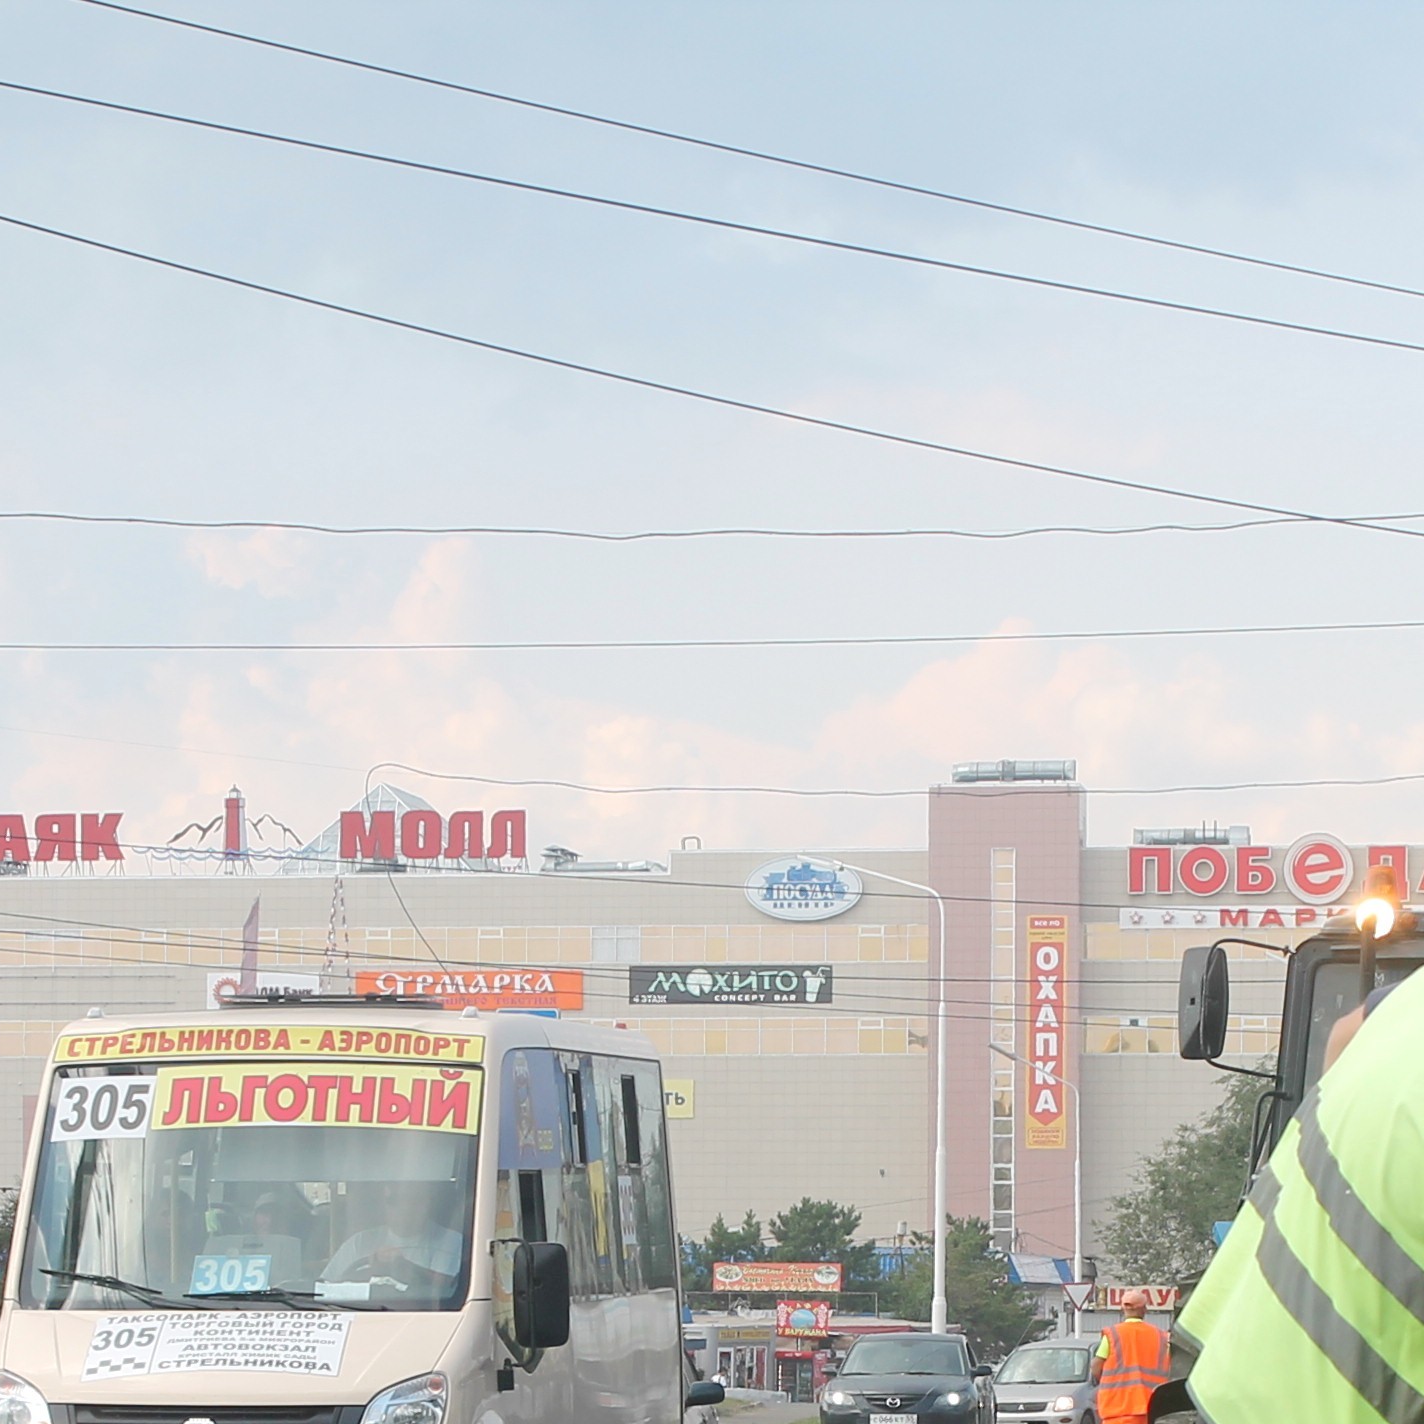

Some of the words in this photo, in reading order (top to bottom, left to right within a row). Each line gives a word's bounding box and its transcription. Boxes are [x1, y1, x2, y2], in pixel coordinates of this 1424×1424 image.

[339, 809, 527, 859] МОЛЛ
[375, 971, 556, 996] ЯРМАРКА
[714, 994, 765, 1002] CONCEPT
[774, 994, 797, 1002] BAR
[1034, 945, 1059, 1113] ОХАПКА
[67, 1029, 291, 1058] СТРЕЛЬНИКОВА
[317, 1029, 471, 1058] АЭРОПОРТ
[59, 1082, 152, 1132] 305
[161, 1067, 471, 1130] ЛЬГОТНЫЙ
[194, 1258, 267, 1292] 305
[107, 1312, 221, 1325] ТАКСОПАРК
[236, 1311, 342, 1322] АЭРОПОРТ
[169, 1320, 275, 1330] ТОРГОВЫЙ
[279, 1321, 344, 1332] ГОРОД
[91, 1326, 159, 1352] 305
[193, 1329, 315, 1338] КОНТИНЕНТ
[182, 1343, 317, 1354] АВТОВОКЗАЛ
[157, 1357, 333, 1372] СТРЕЛЬНИКОВА
